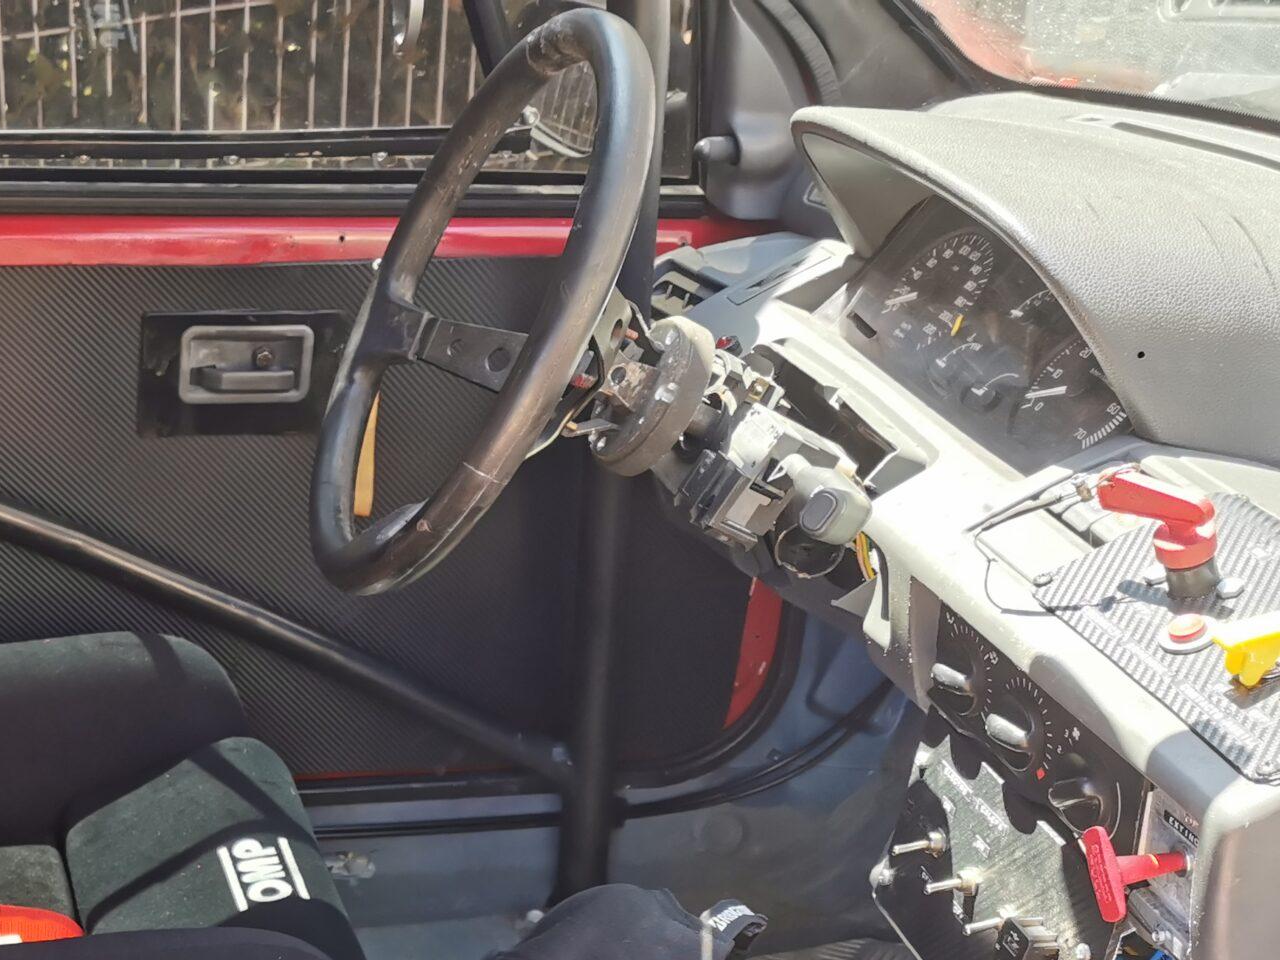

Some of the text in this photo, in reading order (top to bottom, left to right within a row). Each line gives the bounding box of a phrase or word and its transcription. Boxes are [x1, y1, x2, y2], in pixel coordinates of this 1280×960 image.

[1034, 402, 1044, 411] 0
[1073, 427, 1087, 440] 70
[233, 838, 292, 903] OMP
